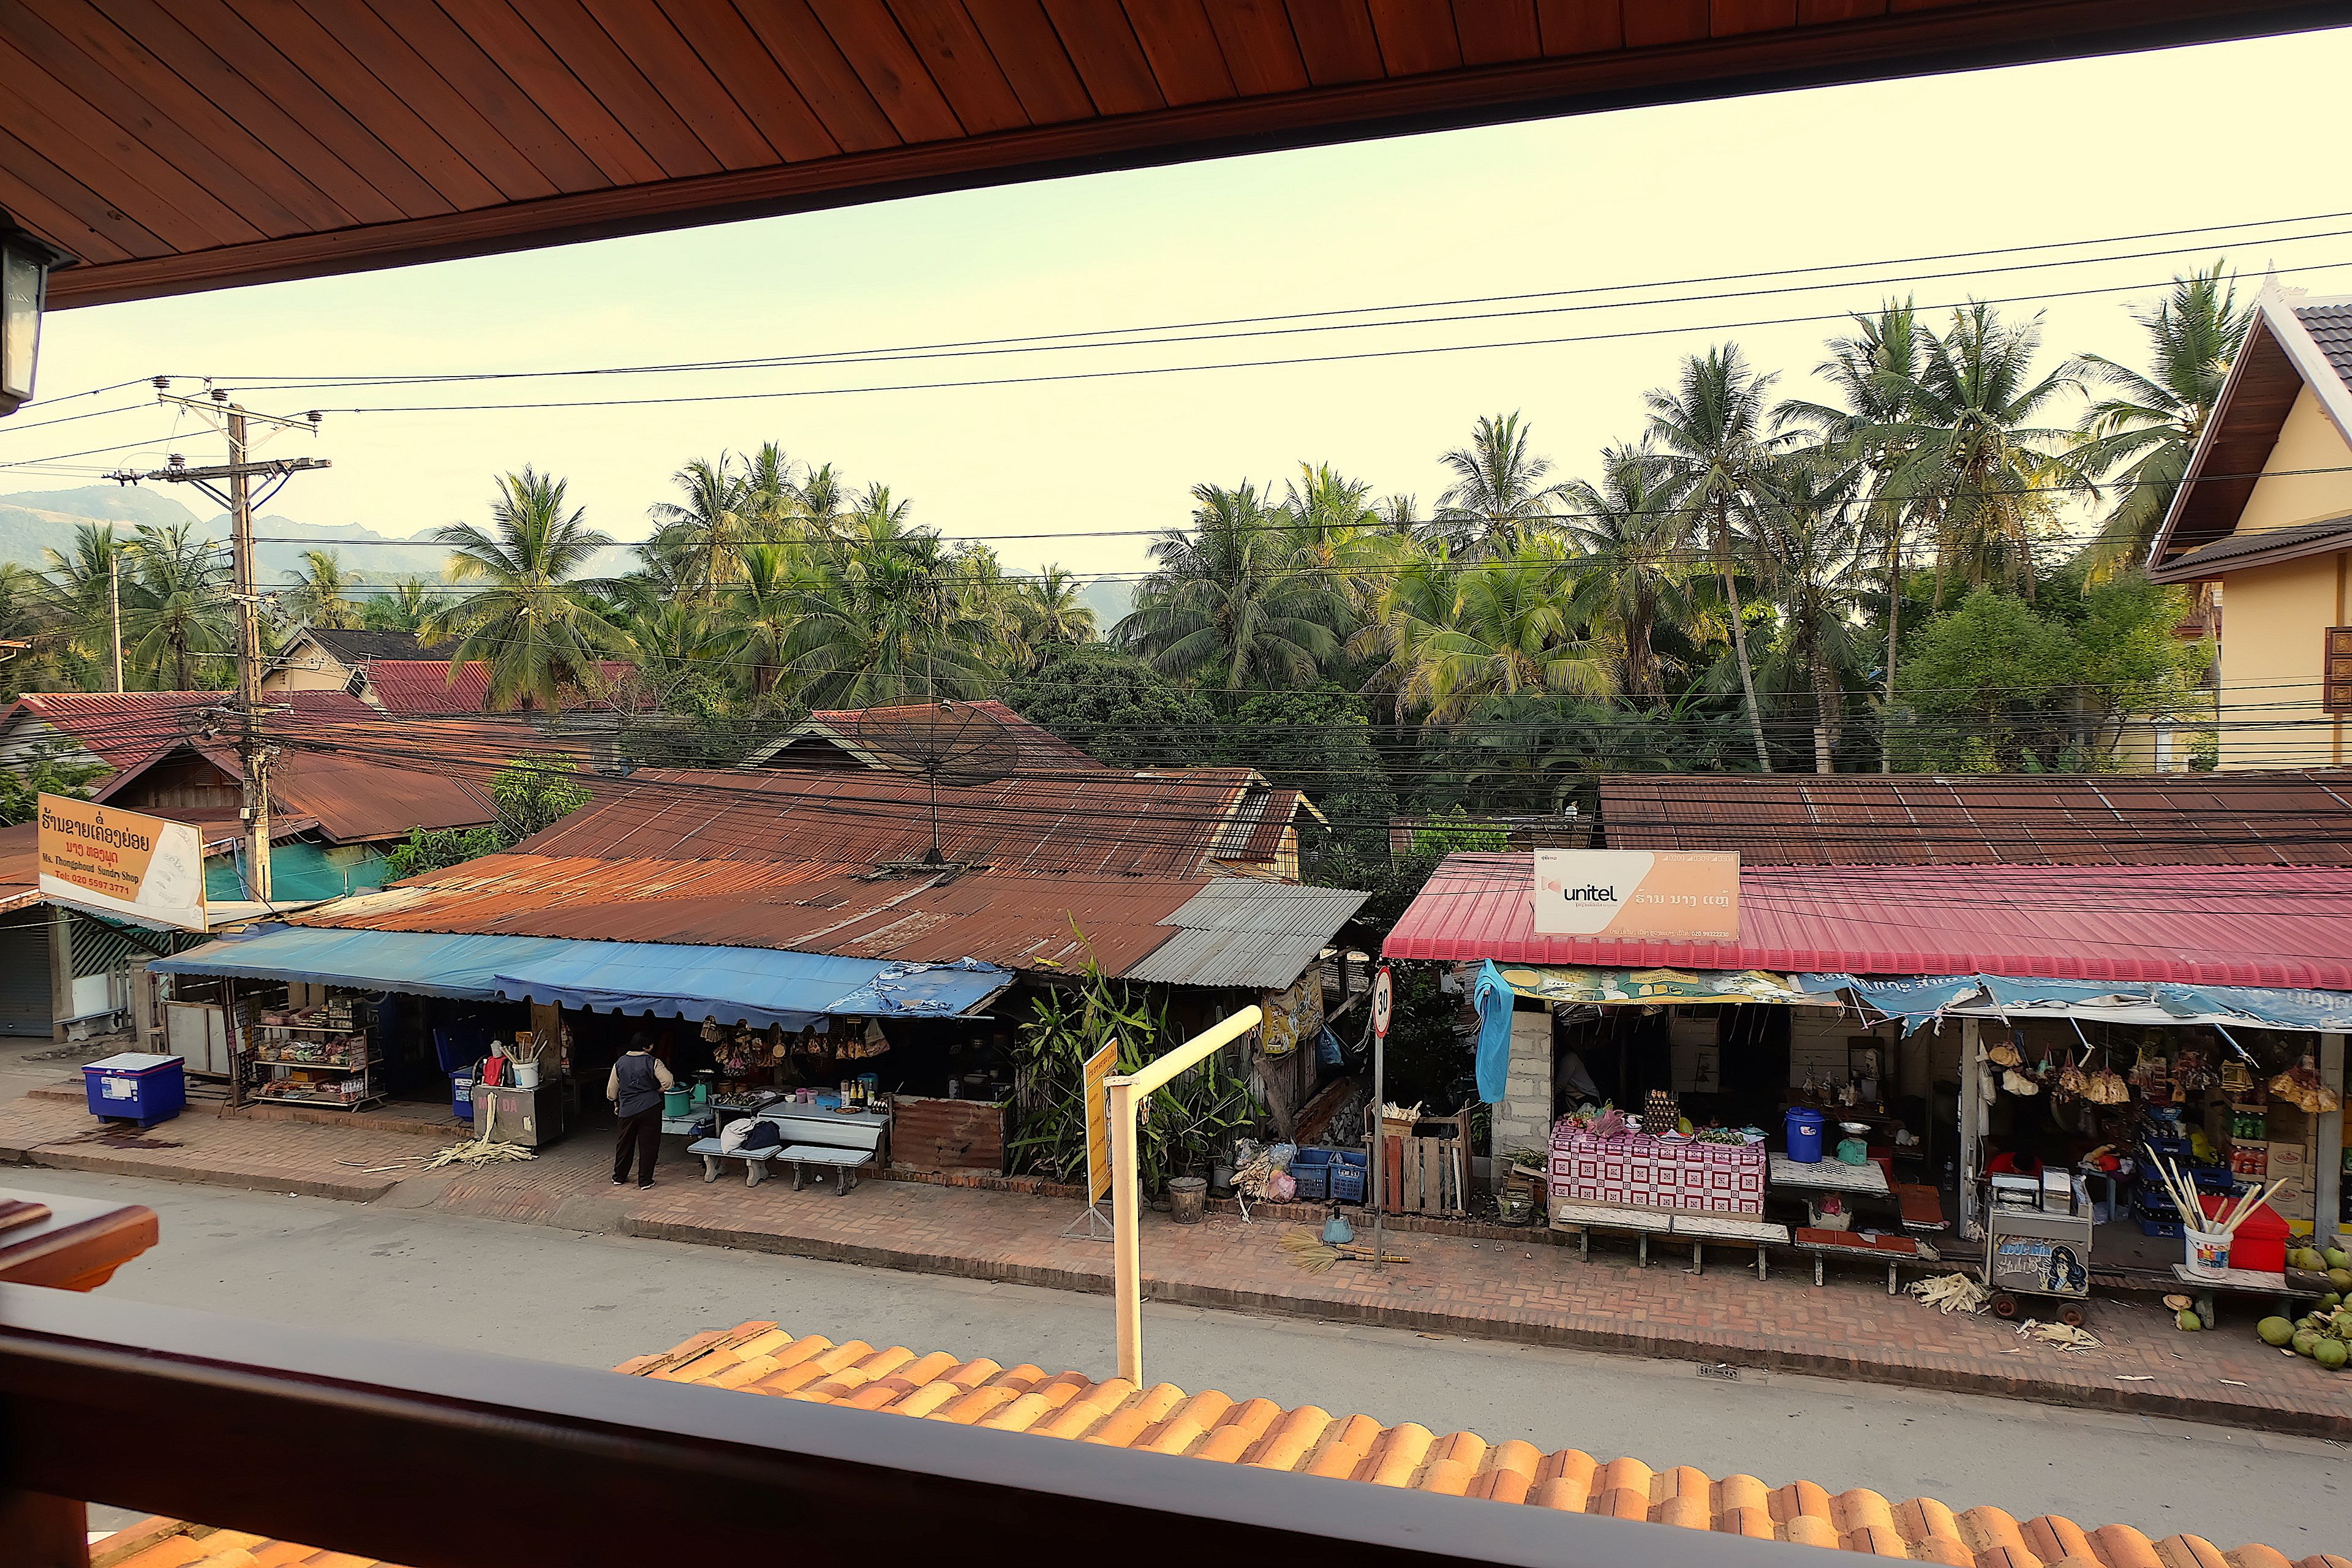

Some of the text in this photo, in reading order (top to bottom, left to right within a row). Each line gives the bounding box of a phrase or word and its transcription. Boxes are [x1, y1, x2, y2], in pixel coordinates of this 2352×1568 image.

[66, 842, 83, 857] ນາງ
[42, 853, 139, 884] Ms. Thongphoud Sundry Shop
[55, 870, 130, 895] Tel: 020 5597 3771
[1564, 884, 1618, 902] unitel
[1635, 888, 1665, 904] ຮ້ານ
[1670, 895, 1697, 907] ນາງ
[1378, 988, 1388, 1016] 30
